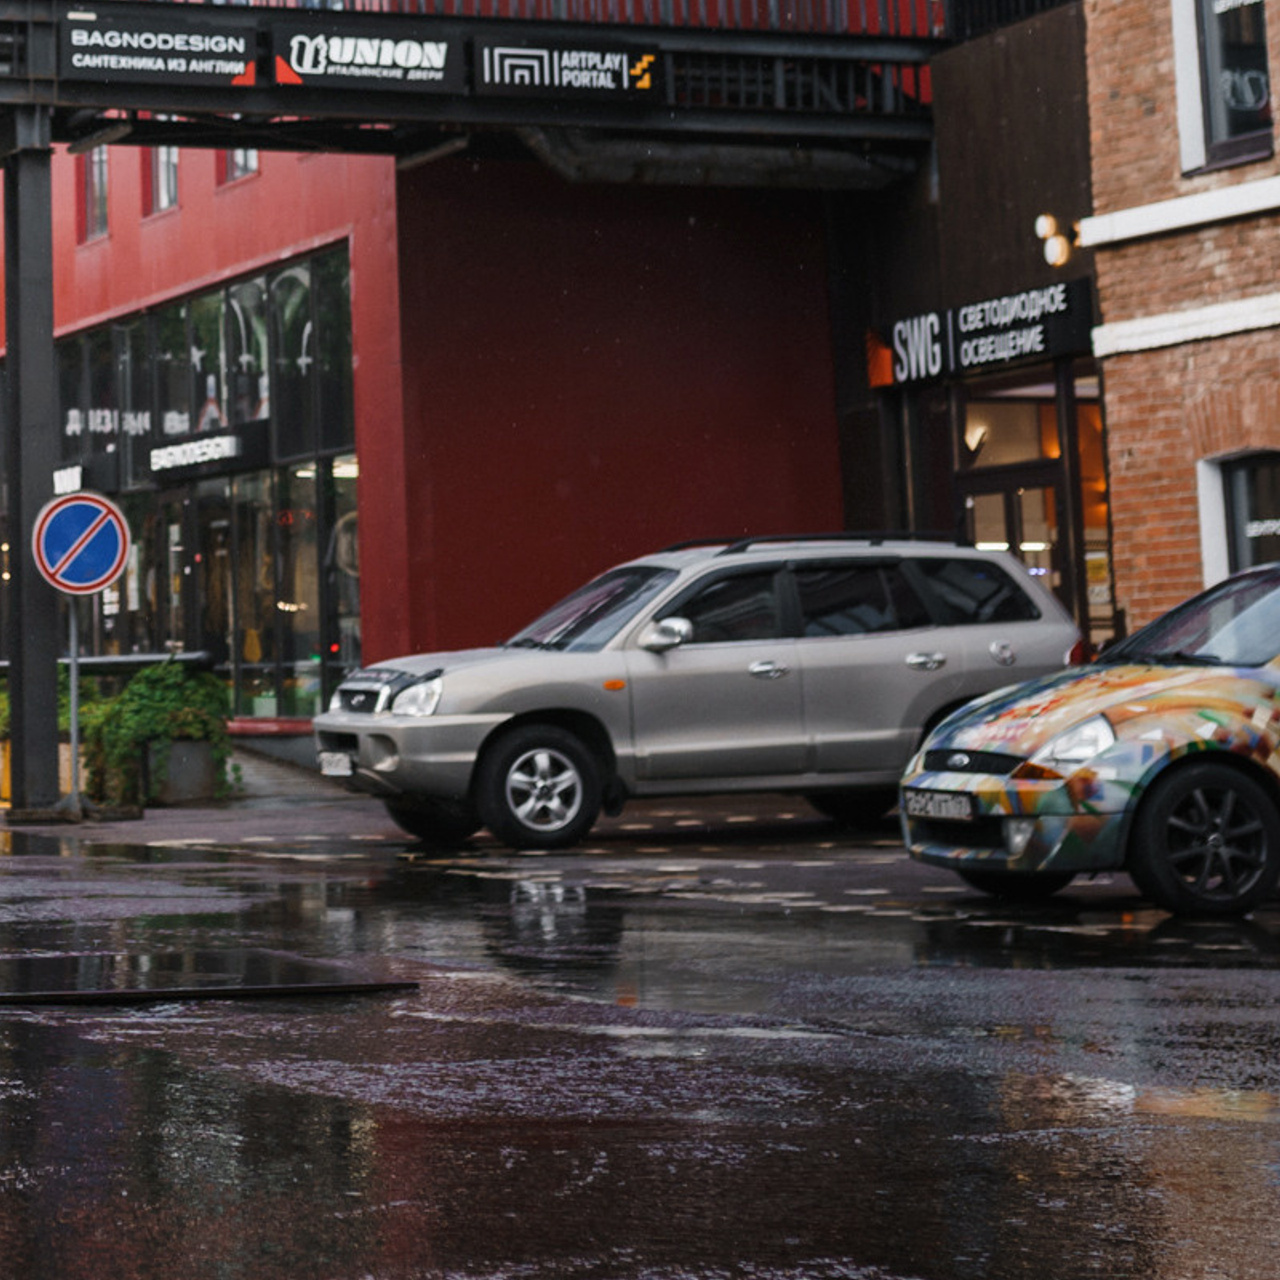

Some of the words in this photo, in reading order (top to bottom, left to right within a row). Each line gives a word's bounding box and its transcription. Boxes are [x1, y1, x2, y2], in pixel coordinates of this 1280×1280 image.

[71, 29, 246, 53] BAGNODESIGN
[328, 36, 448, 69] UNION
[72, 53, 166, 71] САНТЕХНИКА
[168, 58, 187, 72] ИЗ
[189, 59, 246, 75] АНГЛИИ
[561, 50, 621, 70] ARTPLAY
[561, 70, 616, 89] PORTAL
[958, 283, 1067, 332] СВЕТОДИОДНОЕ
[893, 312, 942, 383] SWG
[960, 324, 1045, 367] ОСВЕЩЕНИЕ
